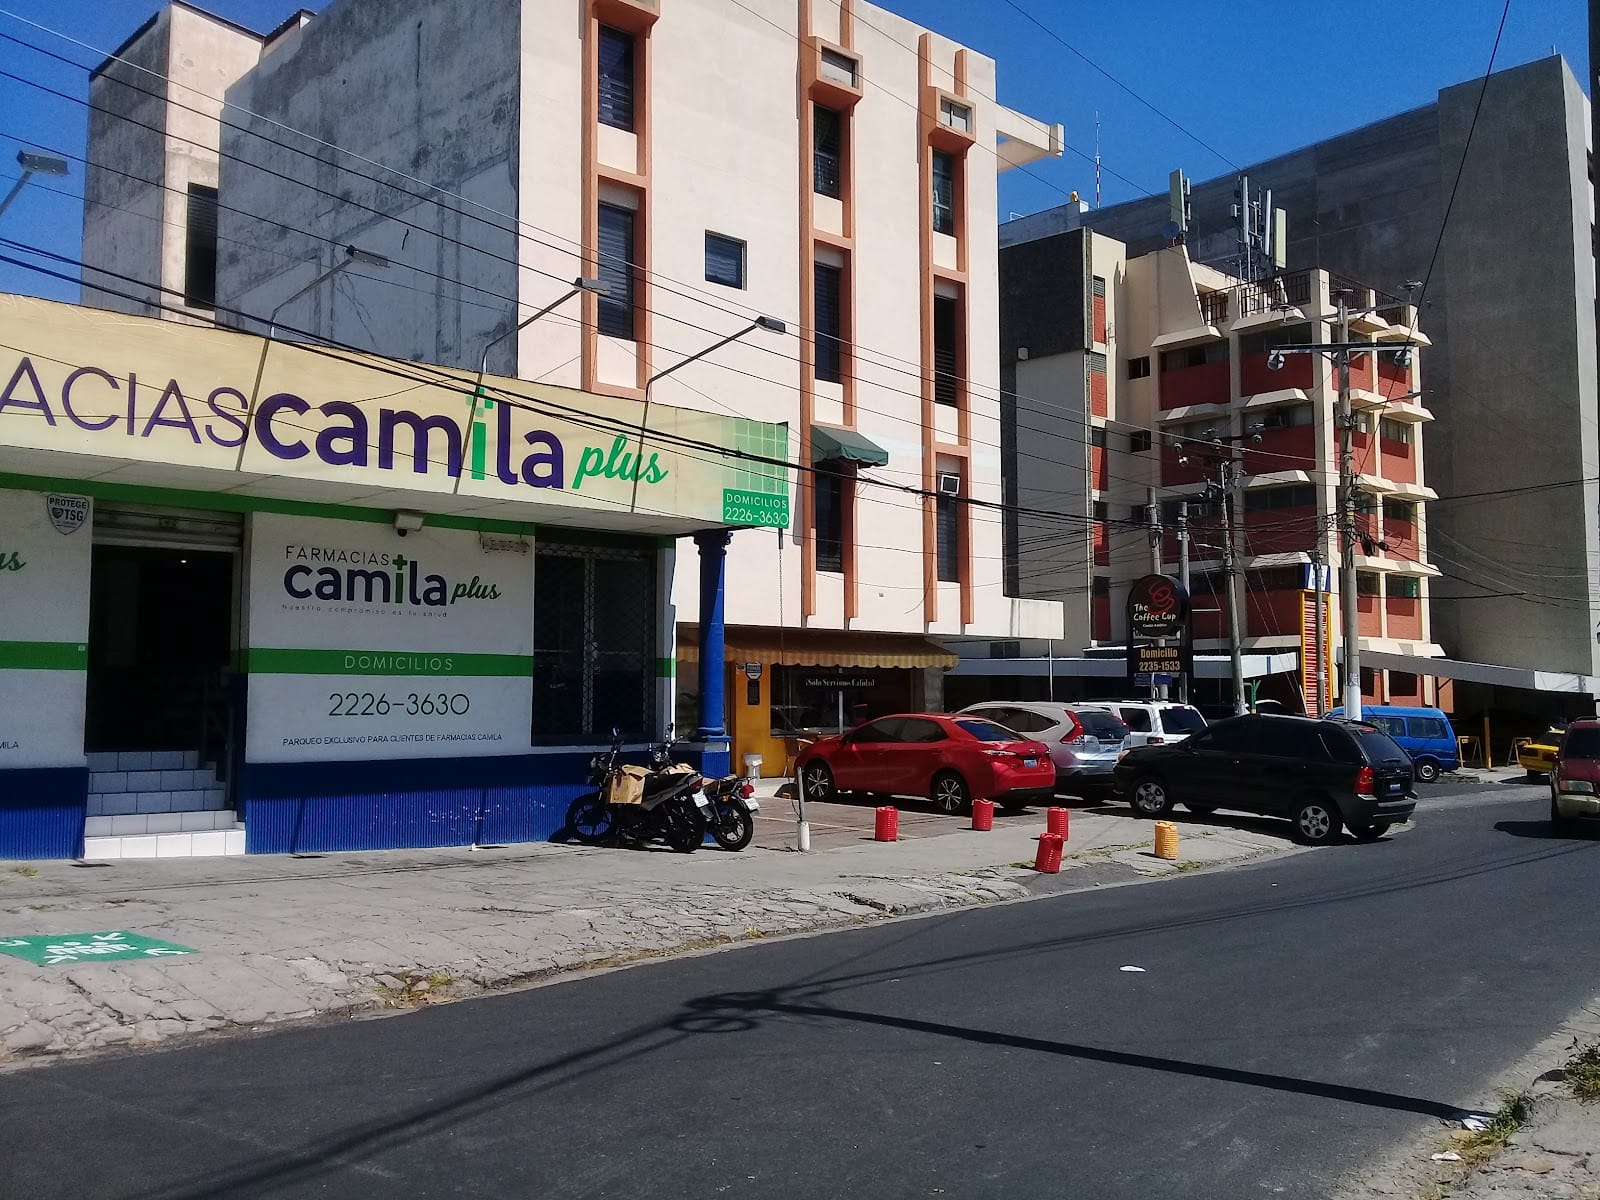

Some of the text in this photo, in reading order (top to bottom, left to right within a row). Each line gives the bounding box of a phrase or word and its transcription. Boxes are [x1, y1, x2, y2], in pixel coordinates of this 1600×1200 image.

[254, 387, 565, 489] camila
[571, 434, 669, 489] plus
[49, 497, 87, 510] PROTEGE
[726, 493, 787, 509] DOMICILIOS
[64, 508, 84, 521] TSG
[725, 507, 789, 526] 2226-3630
[285, 545, 390, 566] FARMACIAS
[283, 554, 502, 607] camila plus
[1133, 603, 1149, 612] The
[1133, 611, 1177, 622] Coffee Cup
[1140, 647, 1178, 659] Domicilio
[344, 655, 453, 671] DOMICILIOS
[1139, 660, 1181, 671] 2235-1533
[328, 693, 470, 716] 2226-3630
[282, 732, 502, 746] PARQUEO EXCLUSIVO PARA CLIENTES DE FARMACIAS CAMILA
